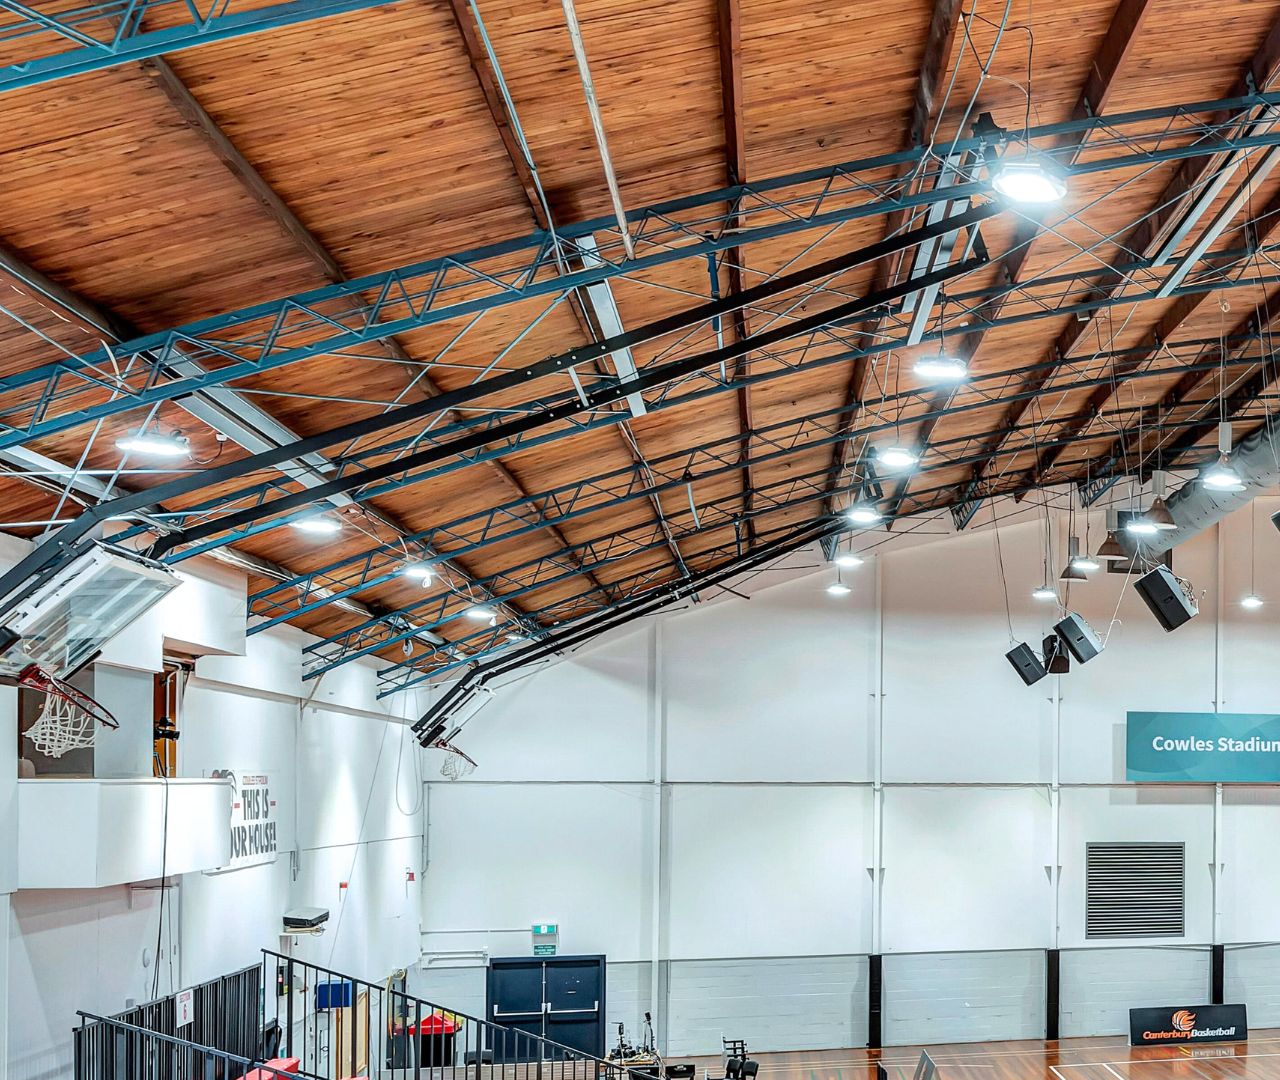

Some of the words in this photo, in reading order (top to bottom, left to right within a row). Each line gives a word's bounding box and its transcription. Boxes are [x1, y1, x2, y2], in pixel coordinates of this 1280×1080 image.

[1152, 736, 1214, 752] Cowles
[242, 789, 260, 820] THIS
[262, 788, 269, 819] IS
[248, 821, 276, 856] HOUSE!
